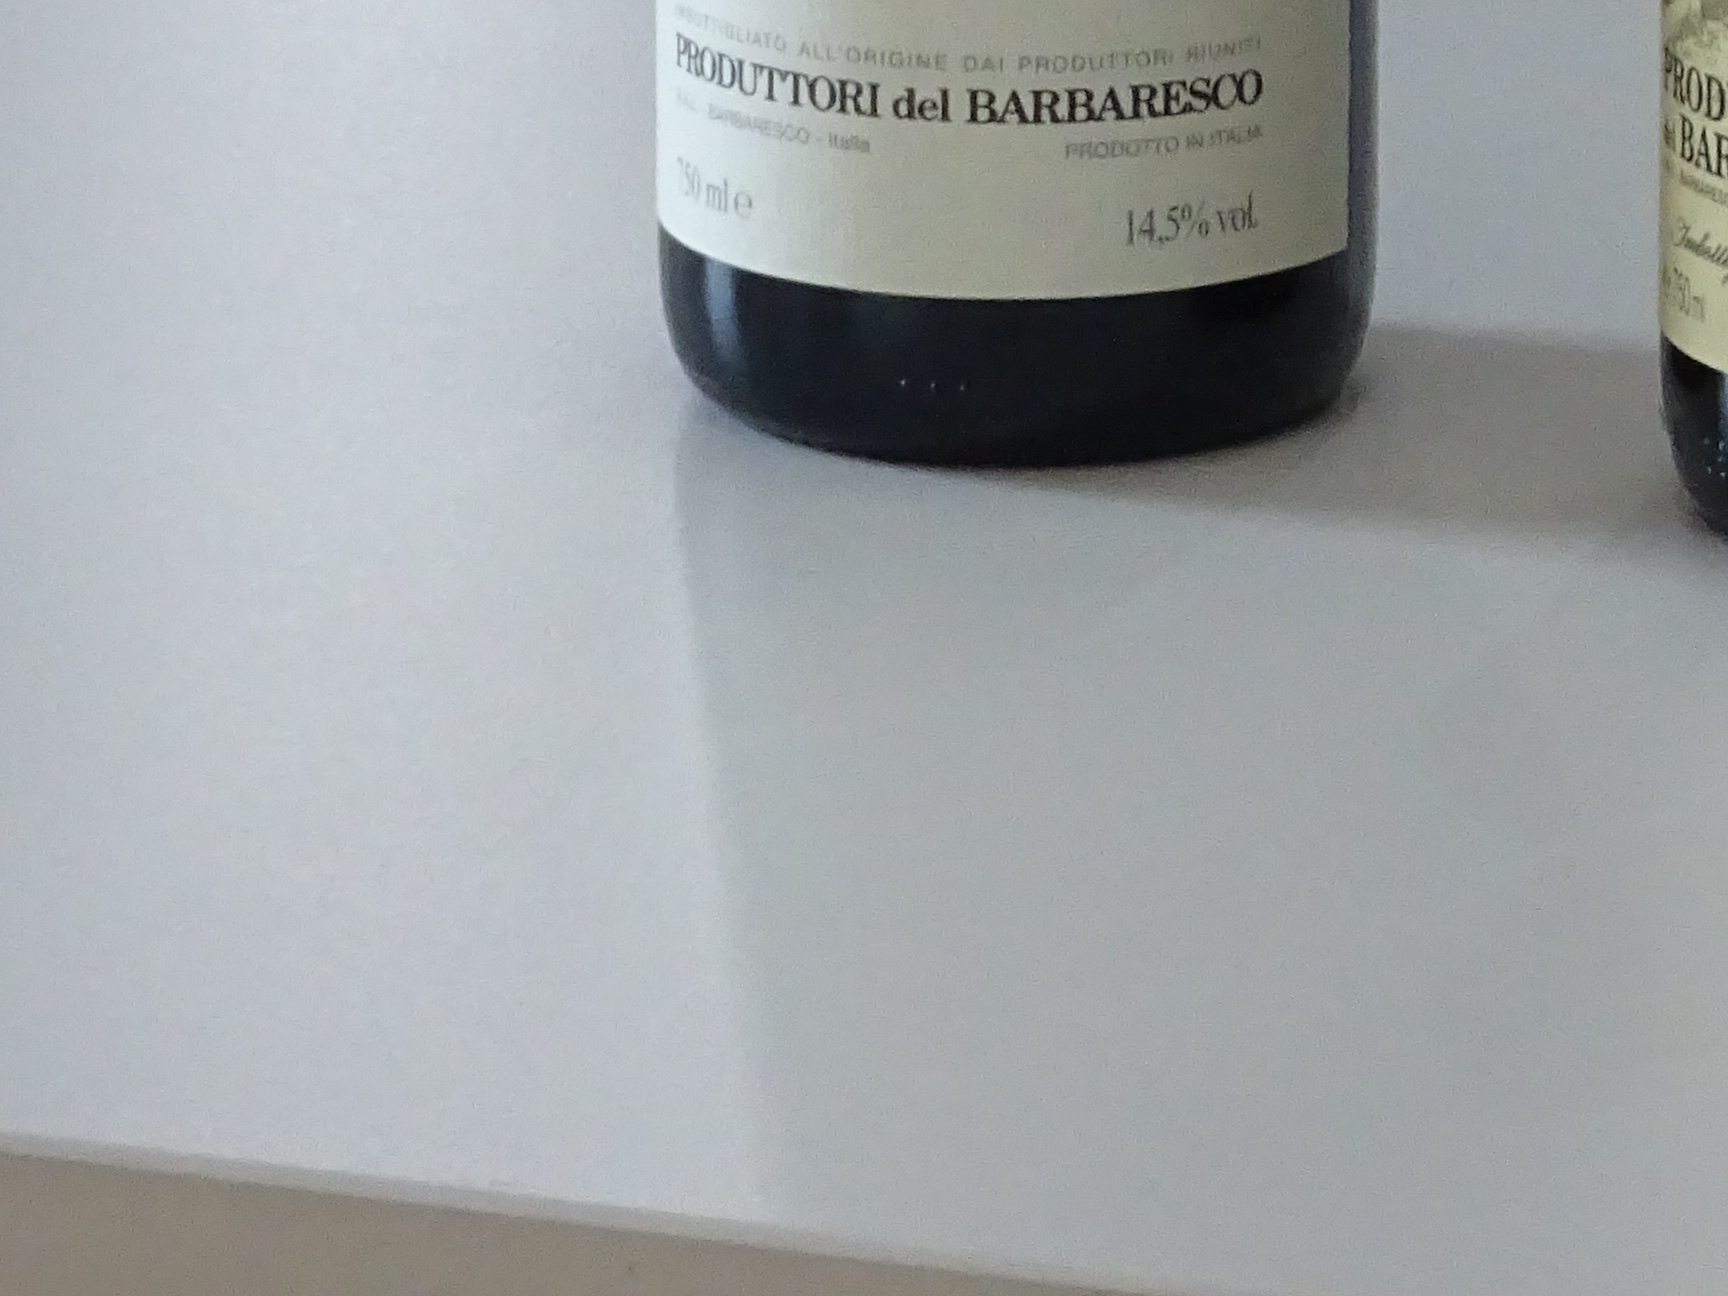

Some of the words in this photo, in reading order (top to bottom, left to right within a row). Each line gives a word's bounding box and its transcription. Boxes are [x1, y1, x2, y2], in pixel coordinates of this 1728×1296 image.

[963, 53, 1005, 74] DAI
[675, 30, 883, 120] PRODUTTORI
[891, 85, 954, 124] del
[966, 68, 1264, 127] BARBARESCO
[1064, 135, 1181, 161] PRODOTTO
